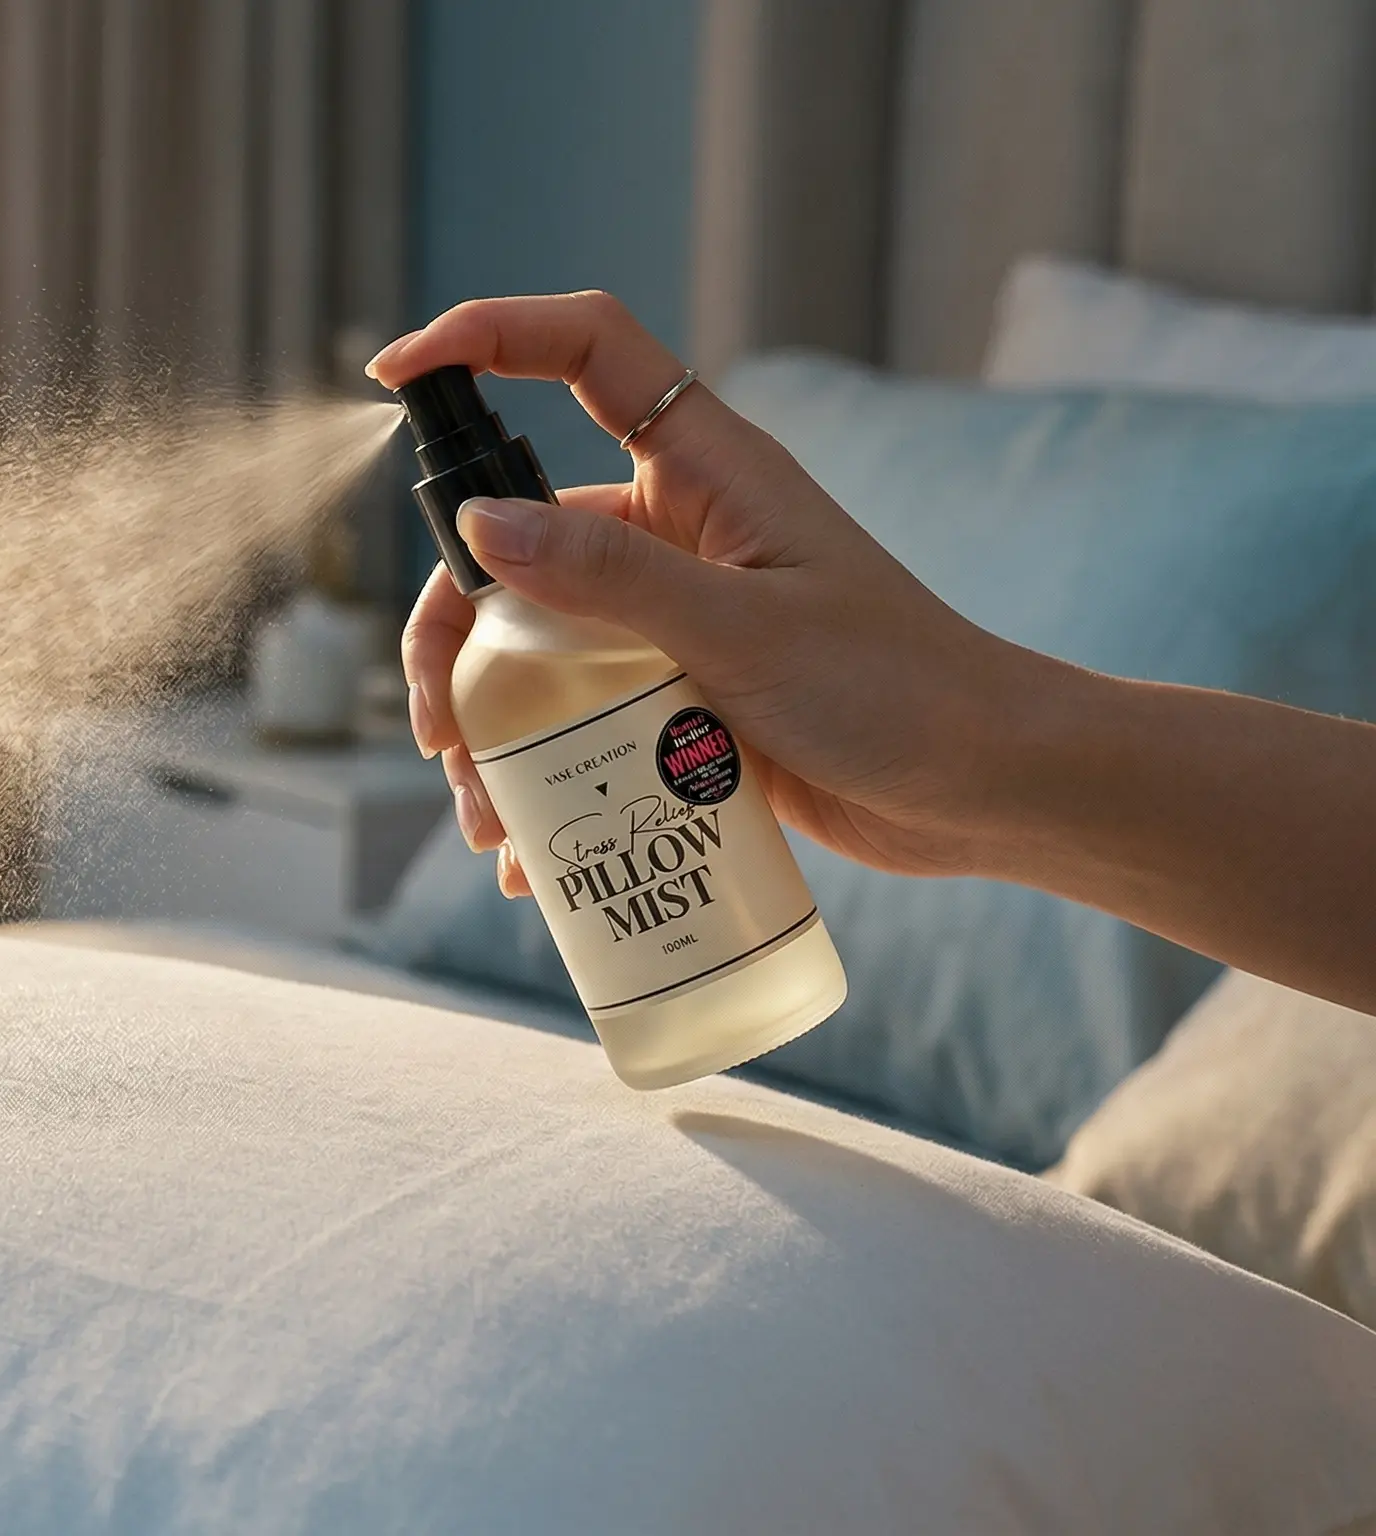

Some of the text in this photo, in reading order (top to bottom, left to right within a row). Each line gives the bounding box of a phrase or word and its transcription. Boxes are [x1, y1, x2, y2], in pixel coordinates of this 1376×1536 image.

[544, 741, 637, 786] VASE CREATION
[664, 728, 731, 778] WINNER
[549, 812, 618, 875] Stress
[556, 808, 722, 913] PILLOW
[601, 864, 716, 943] MIST
[662, 933, 700, 955] 100ML
